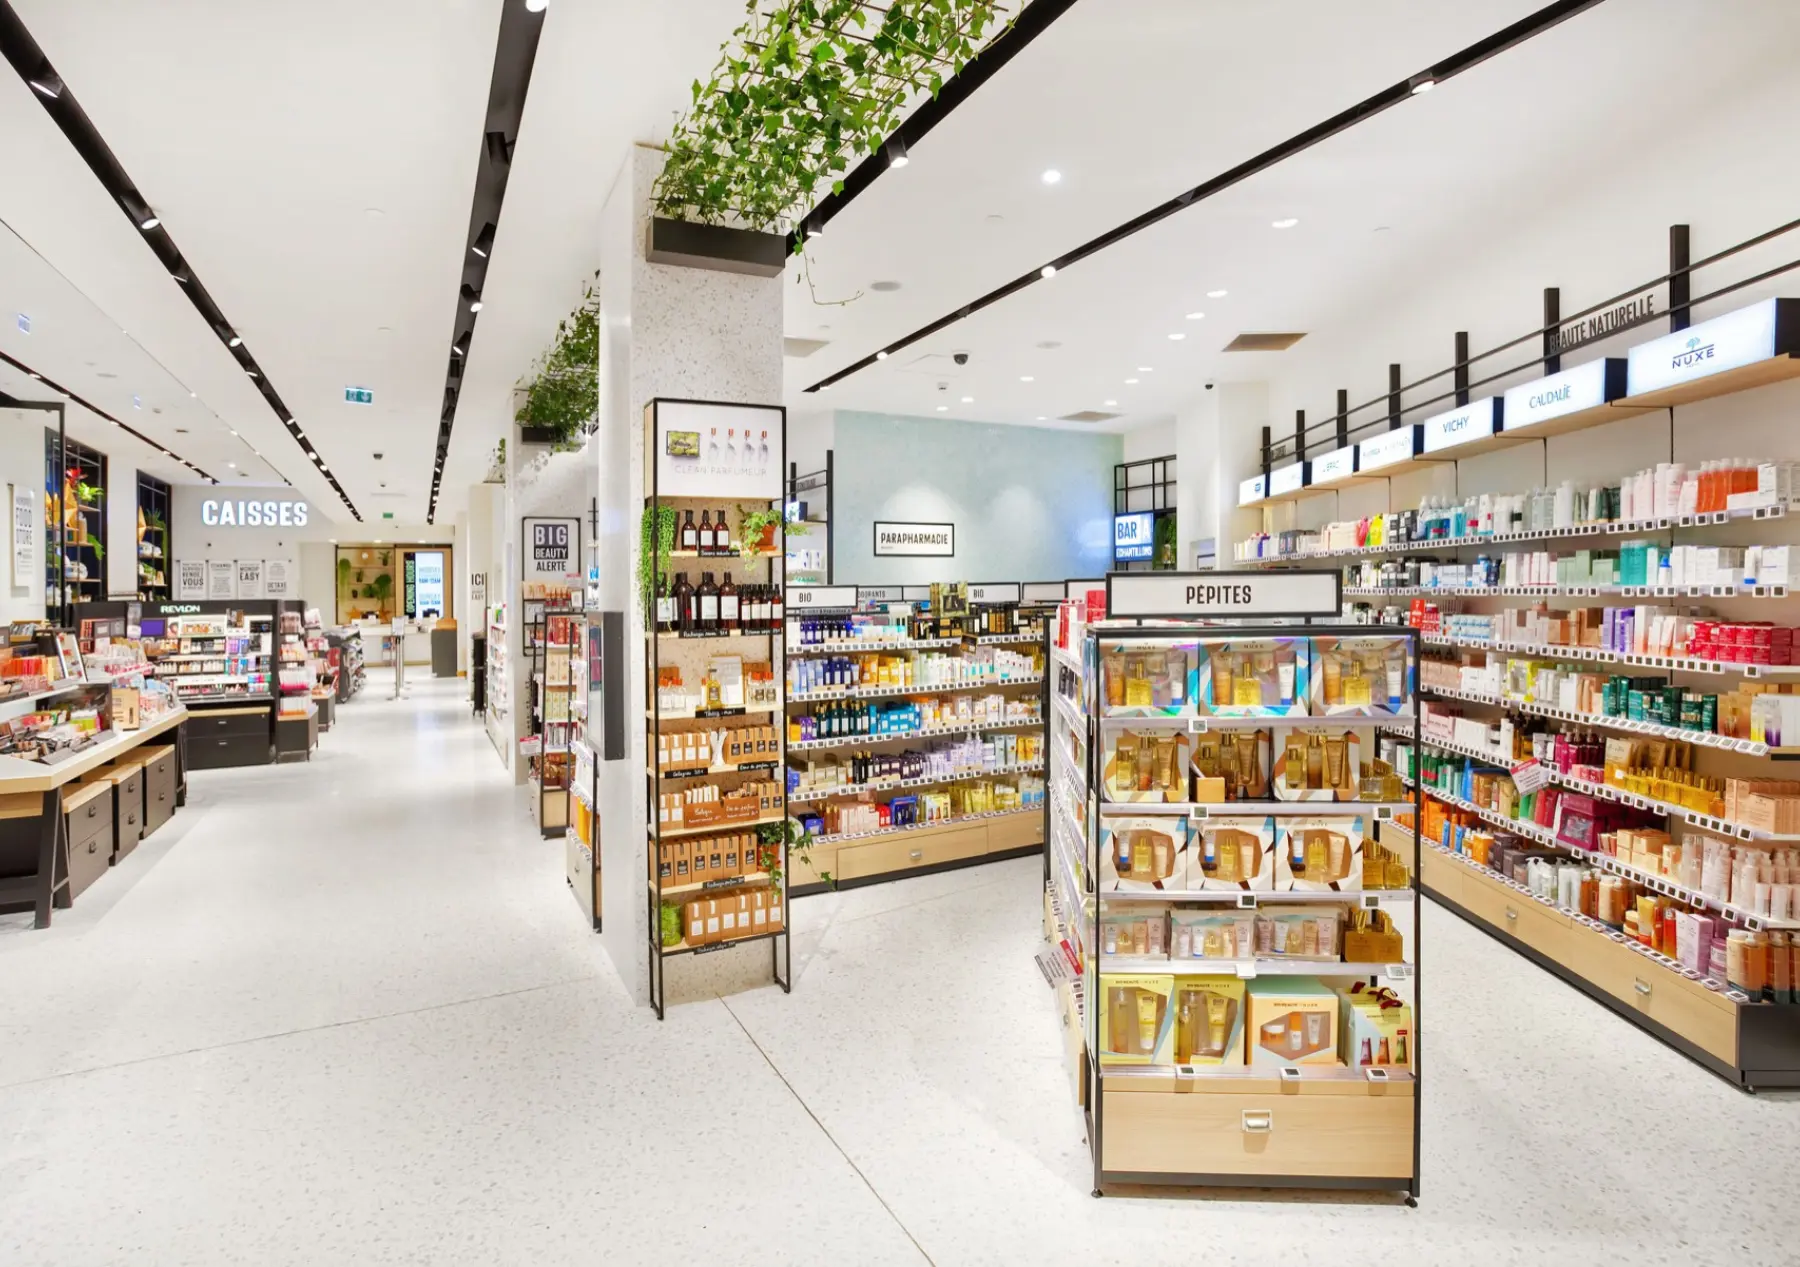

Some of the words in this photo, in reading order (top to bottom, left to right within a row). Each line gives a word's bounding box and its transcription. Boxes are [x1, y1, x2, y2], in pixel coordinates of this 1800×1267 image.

[1589, 294, 1654, 338] NATURELLE
[1672, 347, 1715, 369] NUXE
[1443, 416, 1469, 433] VICHY
[202, 500, 308, 526] CAISSES
[535, 526, 567, 545] BIG
[1117, 522, 1137, 539] BAR
[880, 533, 948, 544] PARAPHARMACIE
[535, 548, 567, 558] BEAUTY
[405, 559, 415, 583] HOURS
[536, 561, 566, 571] ALERTE
[182, 578, 204, 586] VOUS
[240, 572, 260, 581] EASY
[471, 573, 484, 586] ICI
[799, 593, 812, 602] BIO
[973, 589, 984, 598] BIO
[1186, 585, 1252, 604] PÉPITES
[160, 604, 201, 614] REVLON
